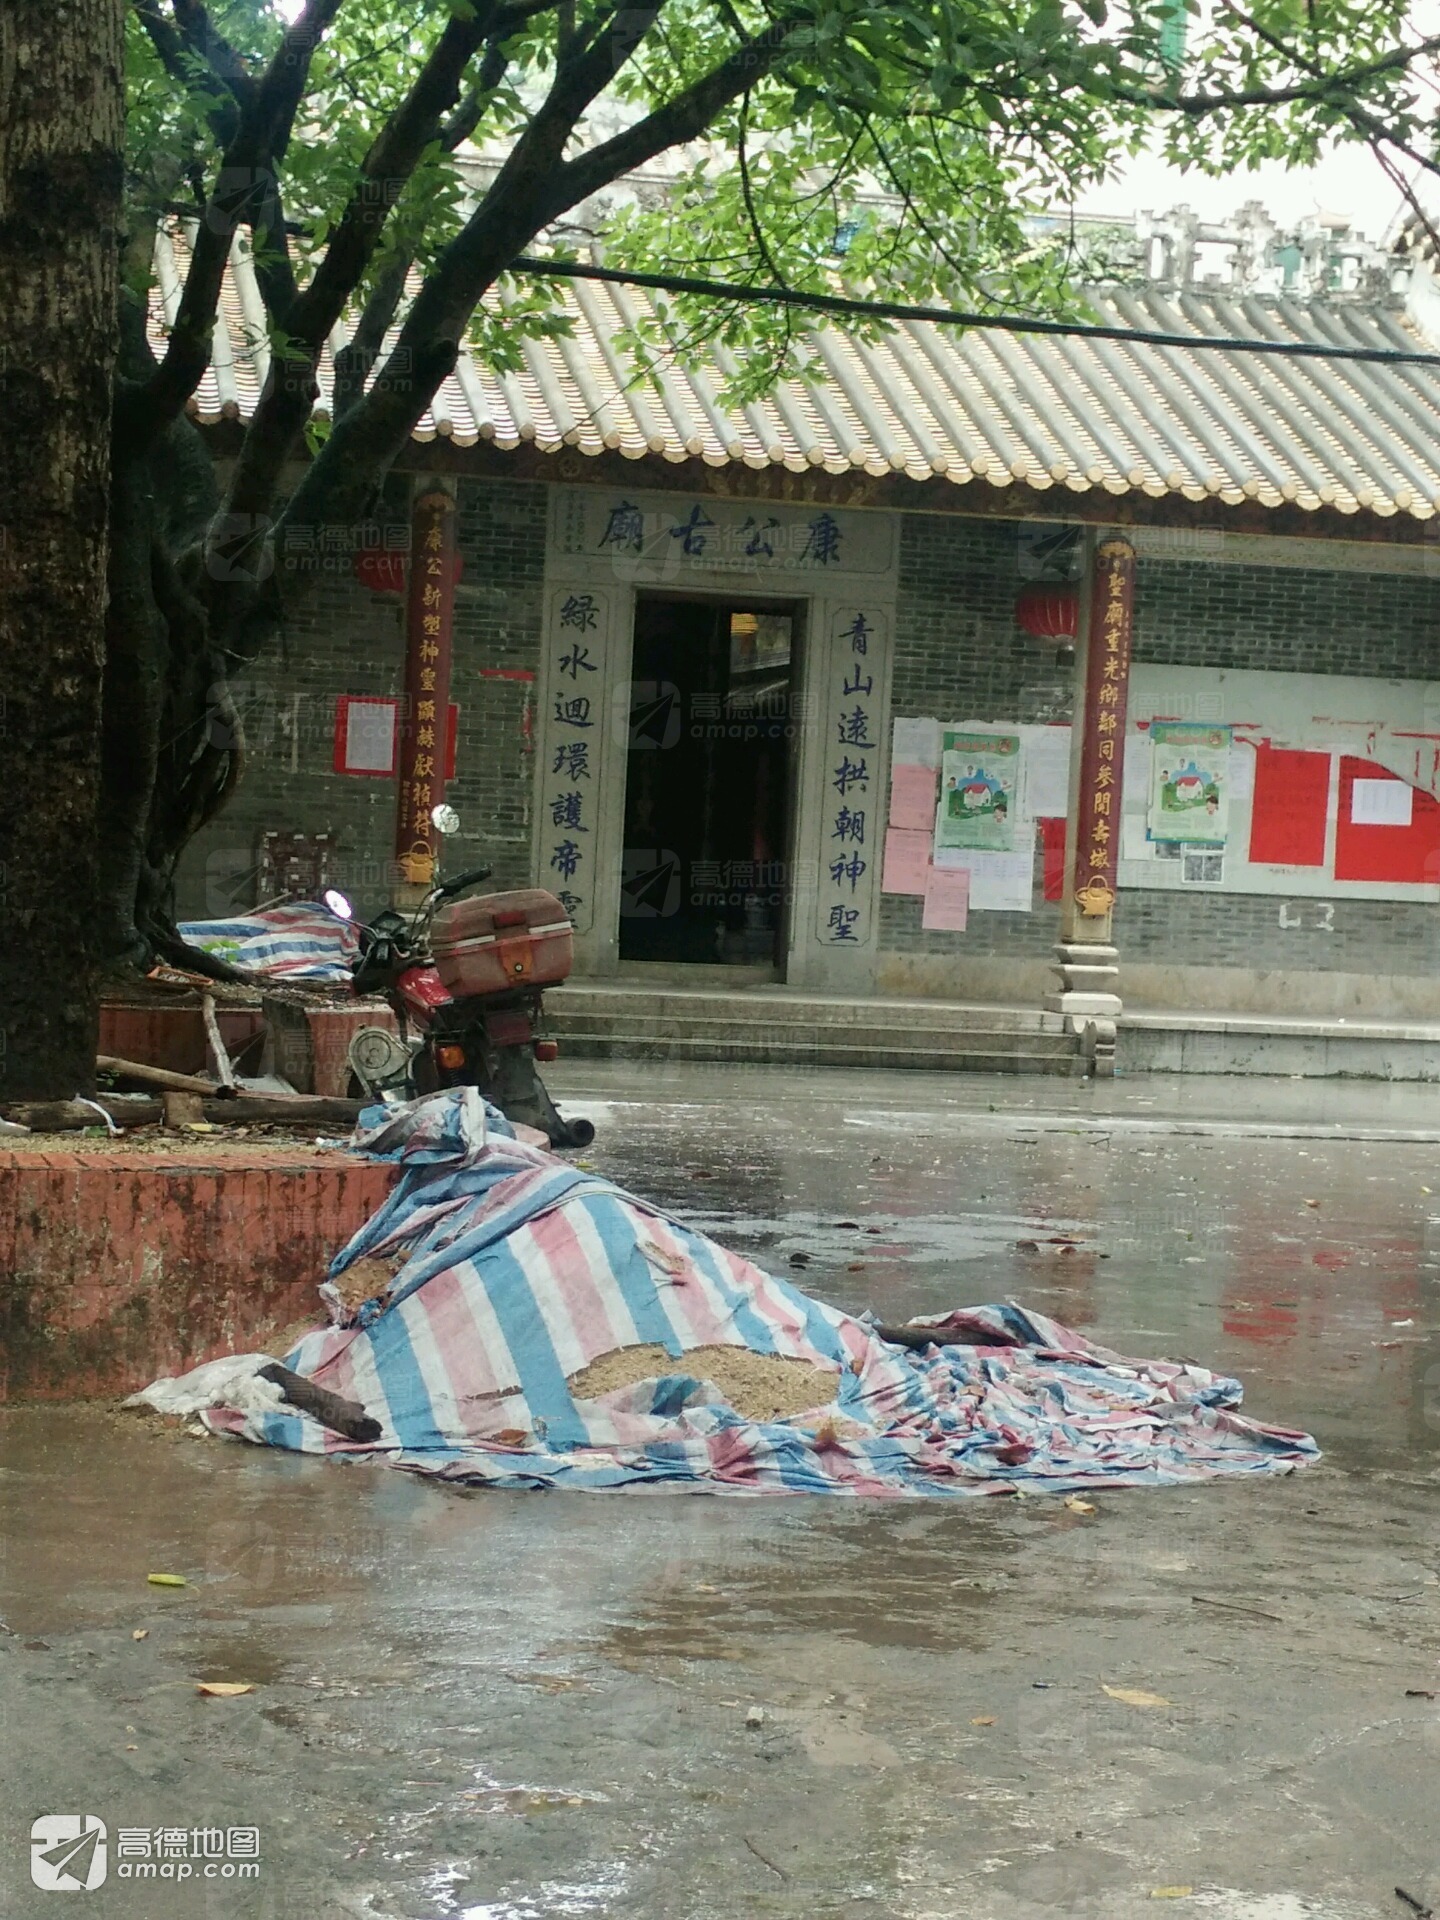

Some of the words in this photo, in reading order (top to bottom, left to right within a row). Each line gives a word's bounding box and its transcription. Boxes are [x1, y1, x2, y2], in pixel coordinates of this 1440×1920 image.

[599, 500, 841, 565] 康公古廟
[827, 613, 876, 942] 青山遠拱朝神聖
